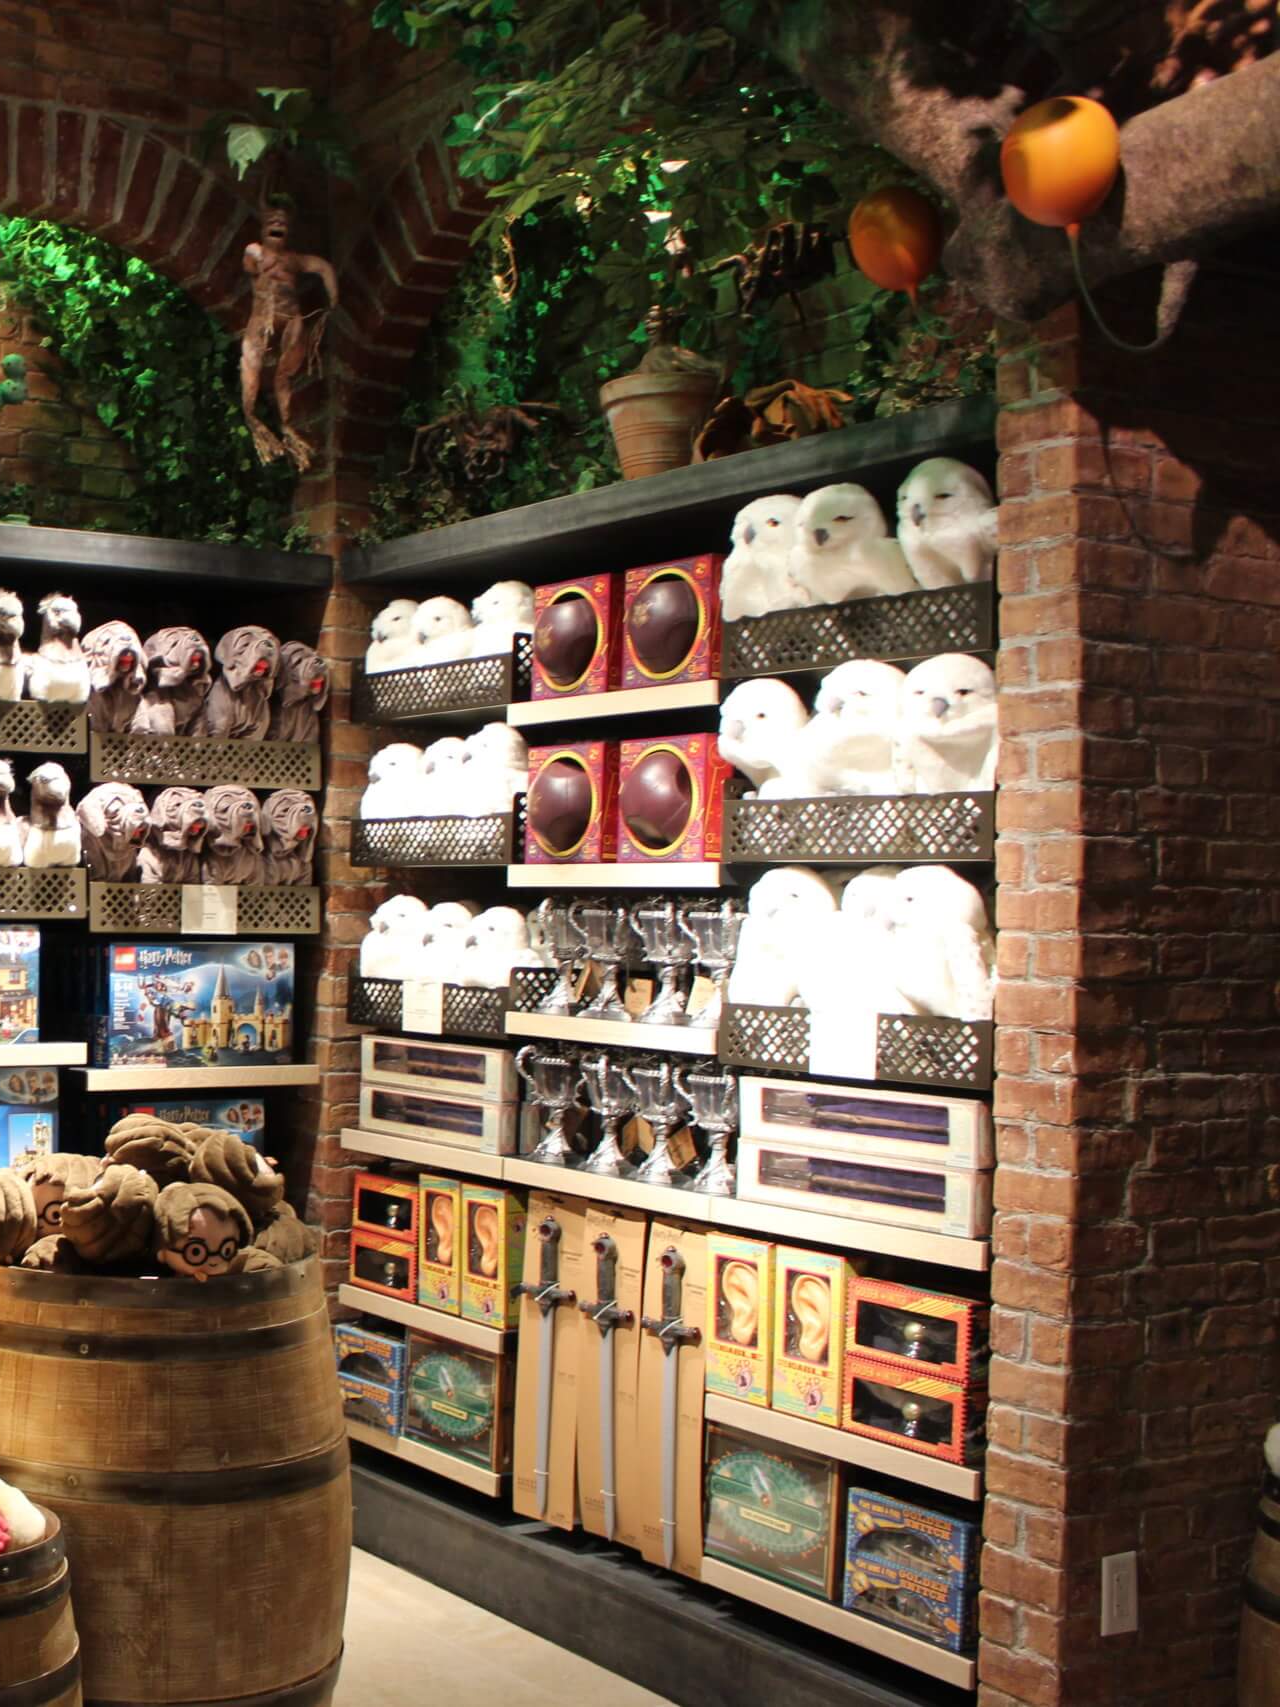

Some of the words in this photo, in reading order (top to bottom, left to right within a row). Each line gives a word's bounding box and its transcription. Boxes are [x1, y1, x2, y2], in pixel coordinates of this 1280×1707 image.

[138, 949, 165, 969] Harry
[165, 947, 193, 965] Potter
[899, 1569, 948, 1593] GOLDEN
